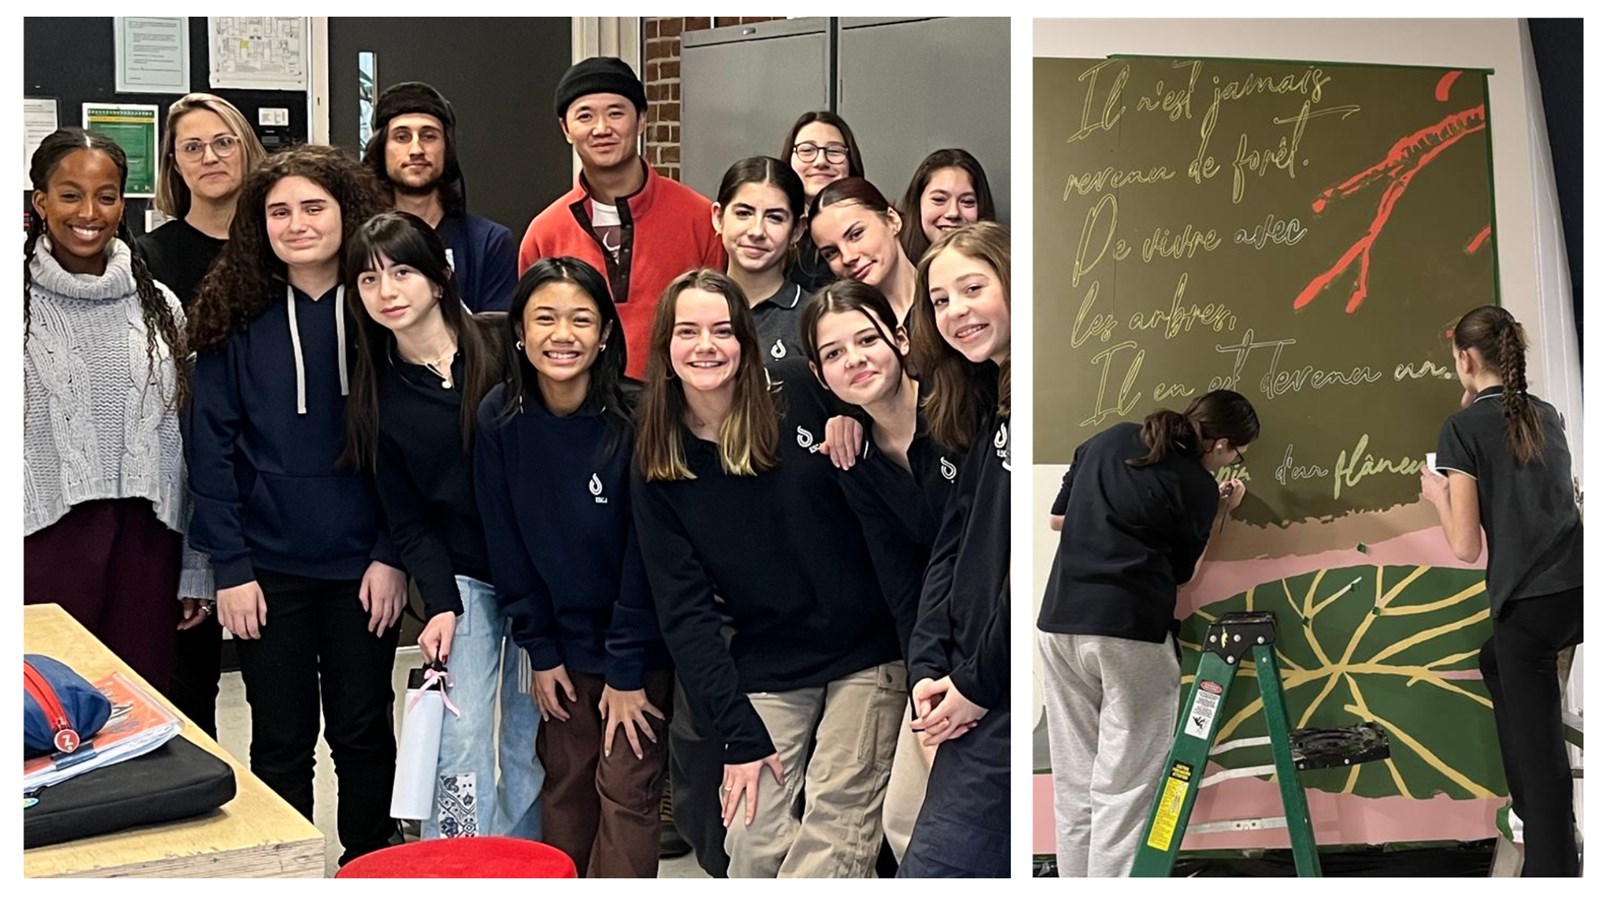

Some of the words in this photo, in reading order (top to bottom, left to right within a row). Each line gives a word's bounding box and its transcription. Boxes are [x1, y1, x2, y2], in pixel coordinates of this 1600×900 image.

[1066, 58, 1130, 143] Il
[1136, 59, 1204, 122] n'est
[1201, 66, 1332, 139] jamais
[1063, 165, 1176, 201] revenu
[1072, 193, 1132, 287] De
[1142, 223, 1222, 263] vivre
[1233, 213, 1308, 250] avec
[1071, 280, 1119, 349] les
[1127, 272, 1237, 340] arbres,
[1079, 340, 1146, 427] Il
[1153, 381, 1196, 402] en
[1207, 328, 1297, 393] est
[1259, 340, 1383, 400] devenu
[1275, 443, 1329, 486] d'un
[1333, 433, 1427, 500] flâneu
